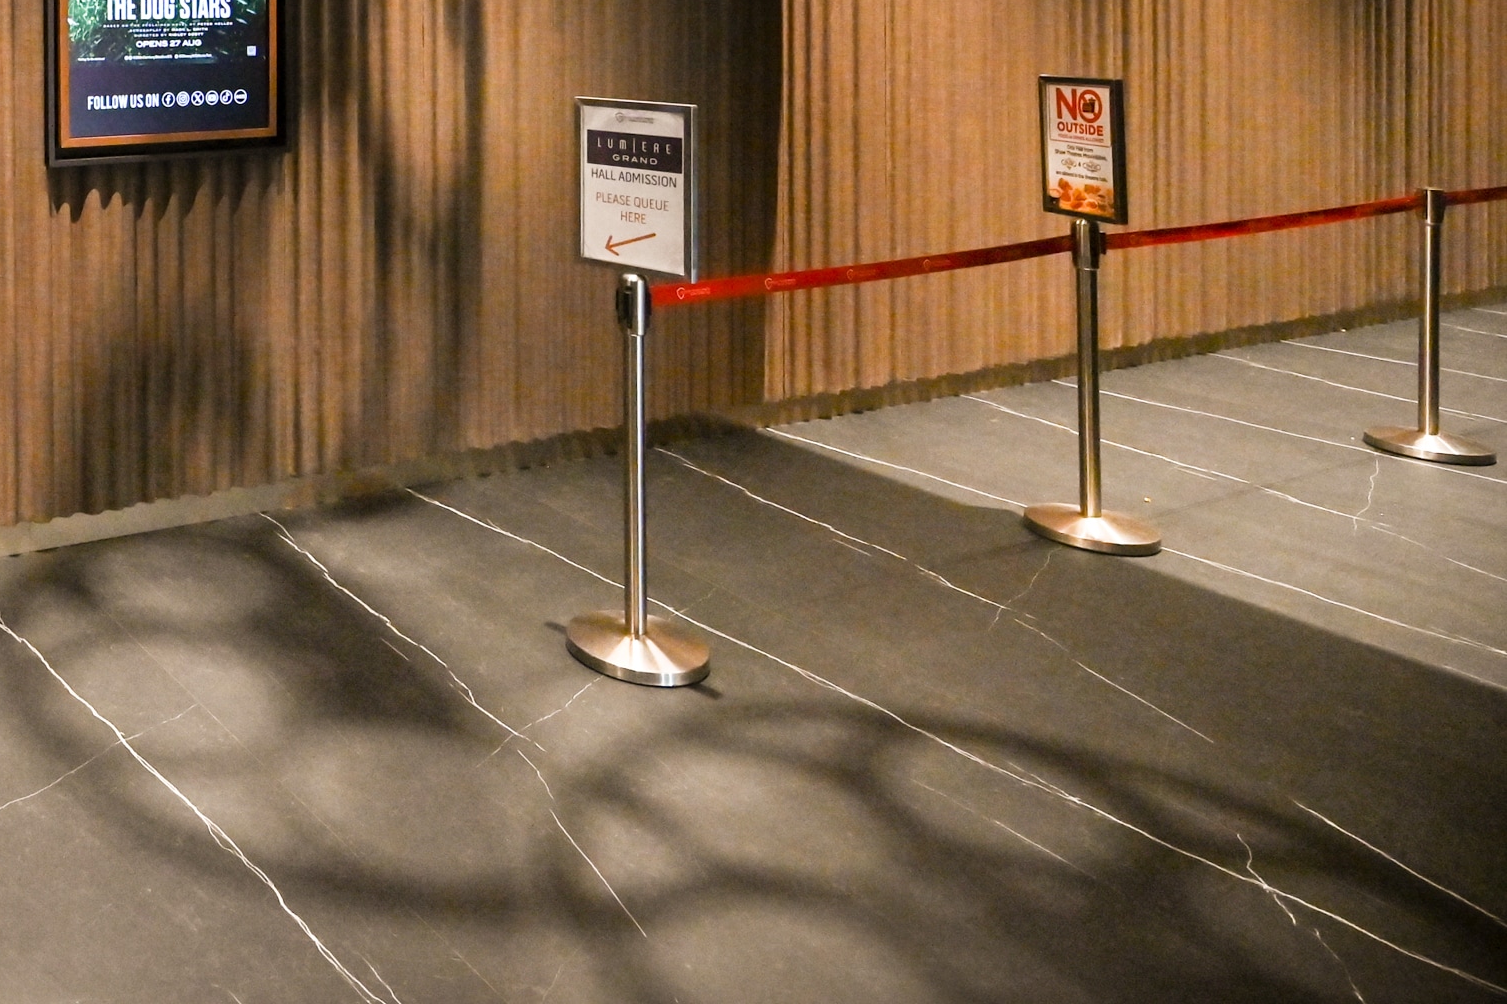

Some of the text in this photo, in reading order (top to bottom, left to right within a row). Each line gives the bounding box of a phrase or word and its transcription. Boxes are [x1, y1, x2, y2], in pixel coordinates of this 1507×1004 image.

[135, 39, 202, 48] OPENS 27 AUG
[87, 93, 160, 111] FOLLOW US ON
[1055, 87, 1103, 123] NO
[1057, 121, 1104, 137] OUTSIDE
[612, 153, 658, 166] GRAND
[591, 168, 677, 188] HALL ADMISSION
[596, 191, 669, 212] PLEASE QUEUE
[620, 211, 647, 225] HERE
